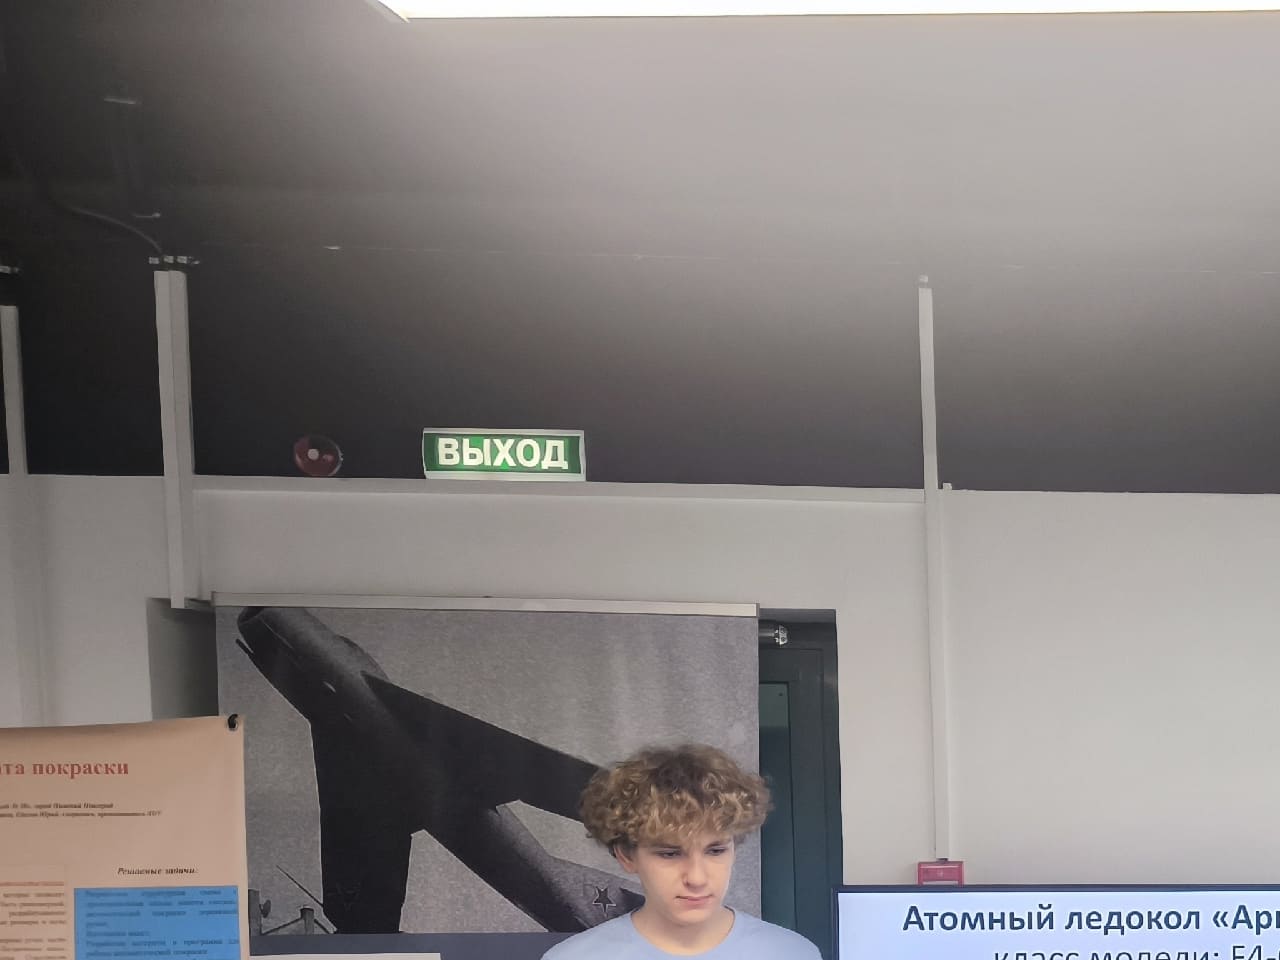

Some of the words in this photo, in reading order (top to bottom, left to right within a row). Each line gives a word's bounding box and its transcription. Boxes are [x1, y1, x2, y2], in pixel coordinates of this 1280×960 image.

[438, 438, 568, 470] ВЫХОД
[0, 763, 25, 775] та
[32, 763, 128, 779] покраски
[902, 903, 1054, 931] Атомный
[1065, 910, 1200, 935] ледокол
